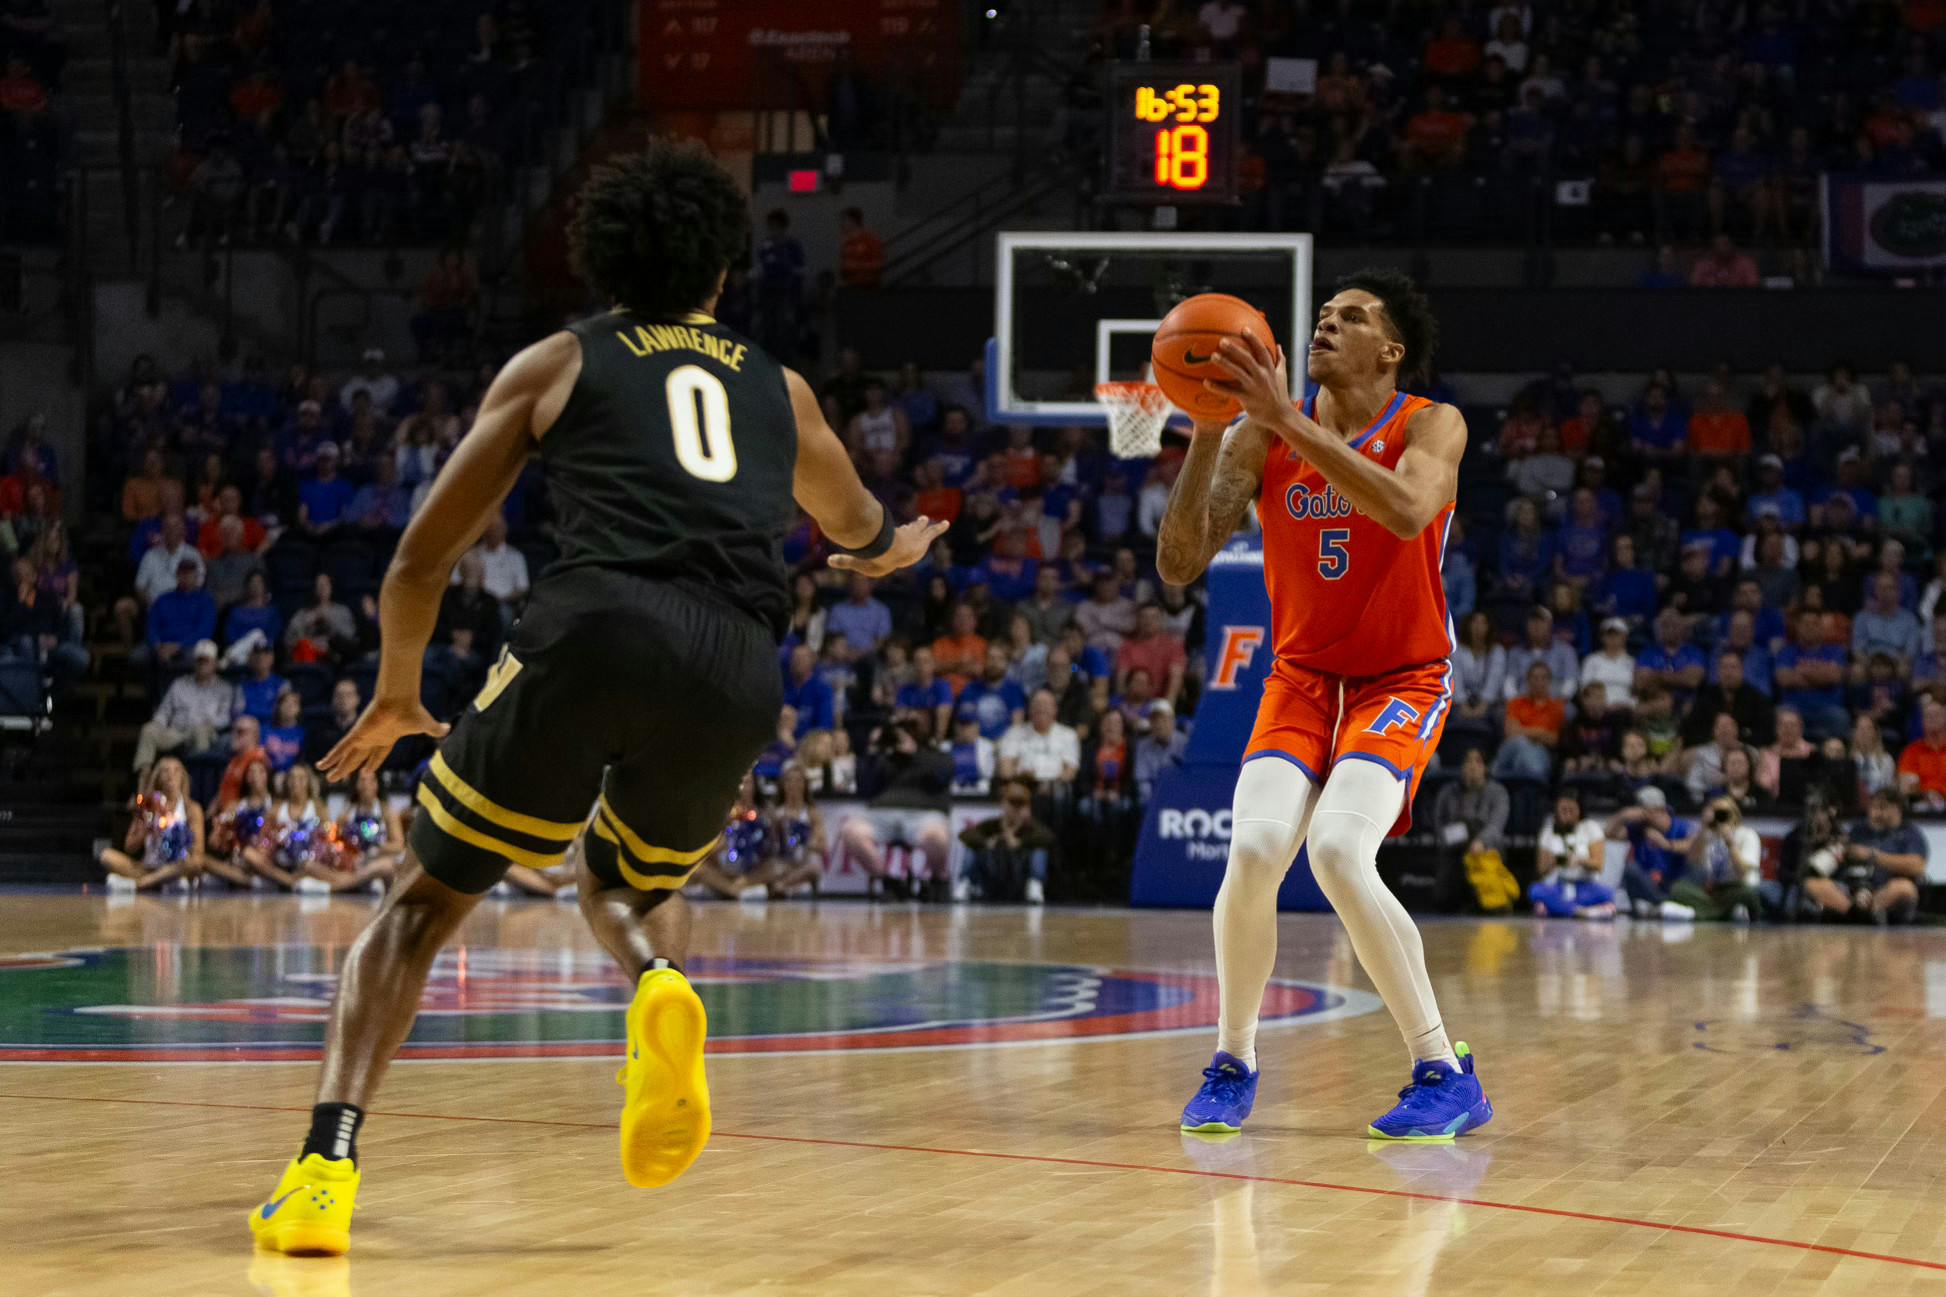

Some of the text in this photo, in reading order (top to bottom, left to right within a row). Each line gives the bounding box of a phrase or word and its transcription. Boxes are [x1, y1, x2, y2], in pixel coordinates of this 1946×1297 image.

[1136, 84, 1220, 124] 16:53
[1155, 124, 1209, 190] 18
[616, 324, 748, 371] LAWRENCE
[666, 363, 738, 483] 0
[1286, 483, 1366, 520] Gato
[1318, 528, 1351, 581] 5
[1208, 625, 1265, 691] F
[1363, 696, 1420, 737] F
